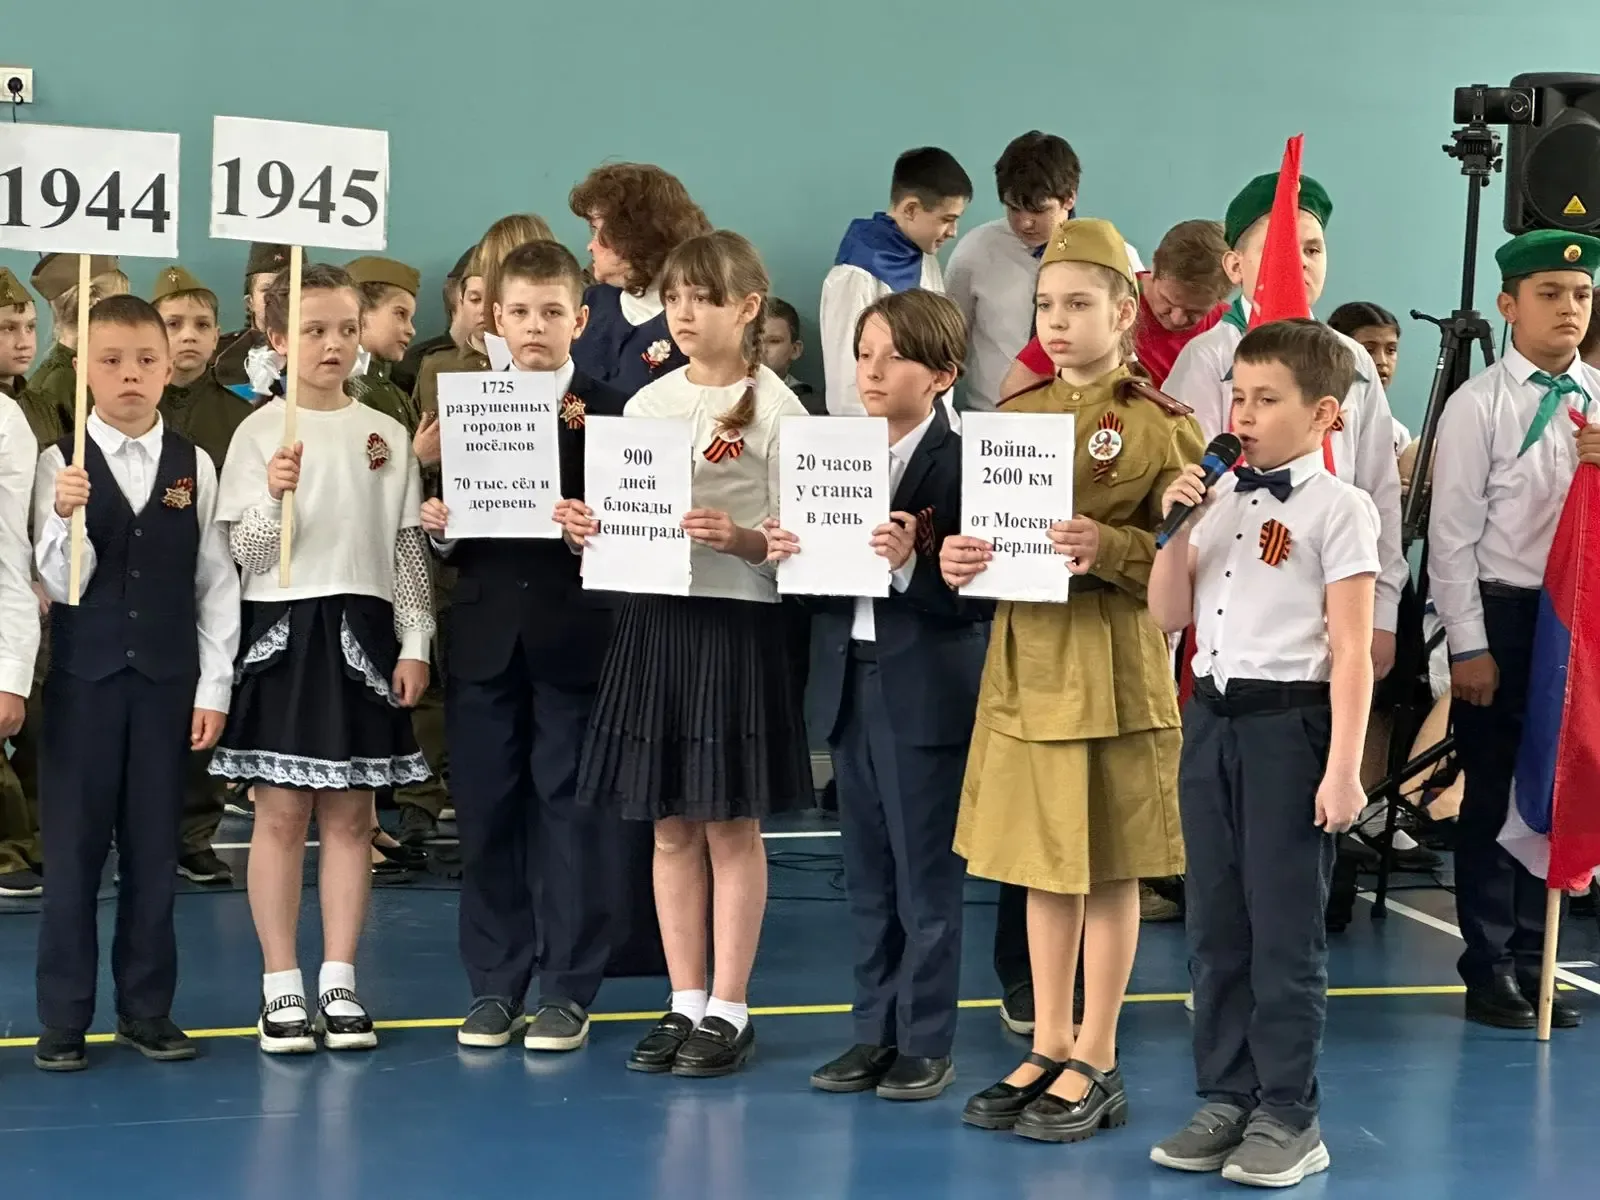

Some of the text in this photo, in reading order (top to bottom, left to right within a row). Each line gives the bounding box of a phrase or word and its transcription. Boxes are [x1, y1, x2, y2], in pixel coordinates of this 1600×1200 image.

[0, 166, 170, 233] 1944
[216, 157, 379, 227] 1945
[481, 381, 514, 393] 1725
[446, 402, 550, 417] разрушенных
[463, 422, 536, 435] городов и
[466, 439, 535, 451] посёлков
[623, 448, 653, 466] 900
[796, 454, 872, 472] 20 часов
[454, 478, 550, 490] 70 тыс. сёл и
[619, 475, 656, 490] дней
[982, 467, 1053, 486] 2600 км
[796, 484, 873, 501] у станка
[468, 499, 536, 512] деревень
[604, 497, 672, 514] блокады
[807, 511, 863, 526] в день
[971, 514, 989, 527] от
[992, 536, 1064, 557] Берлин
